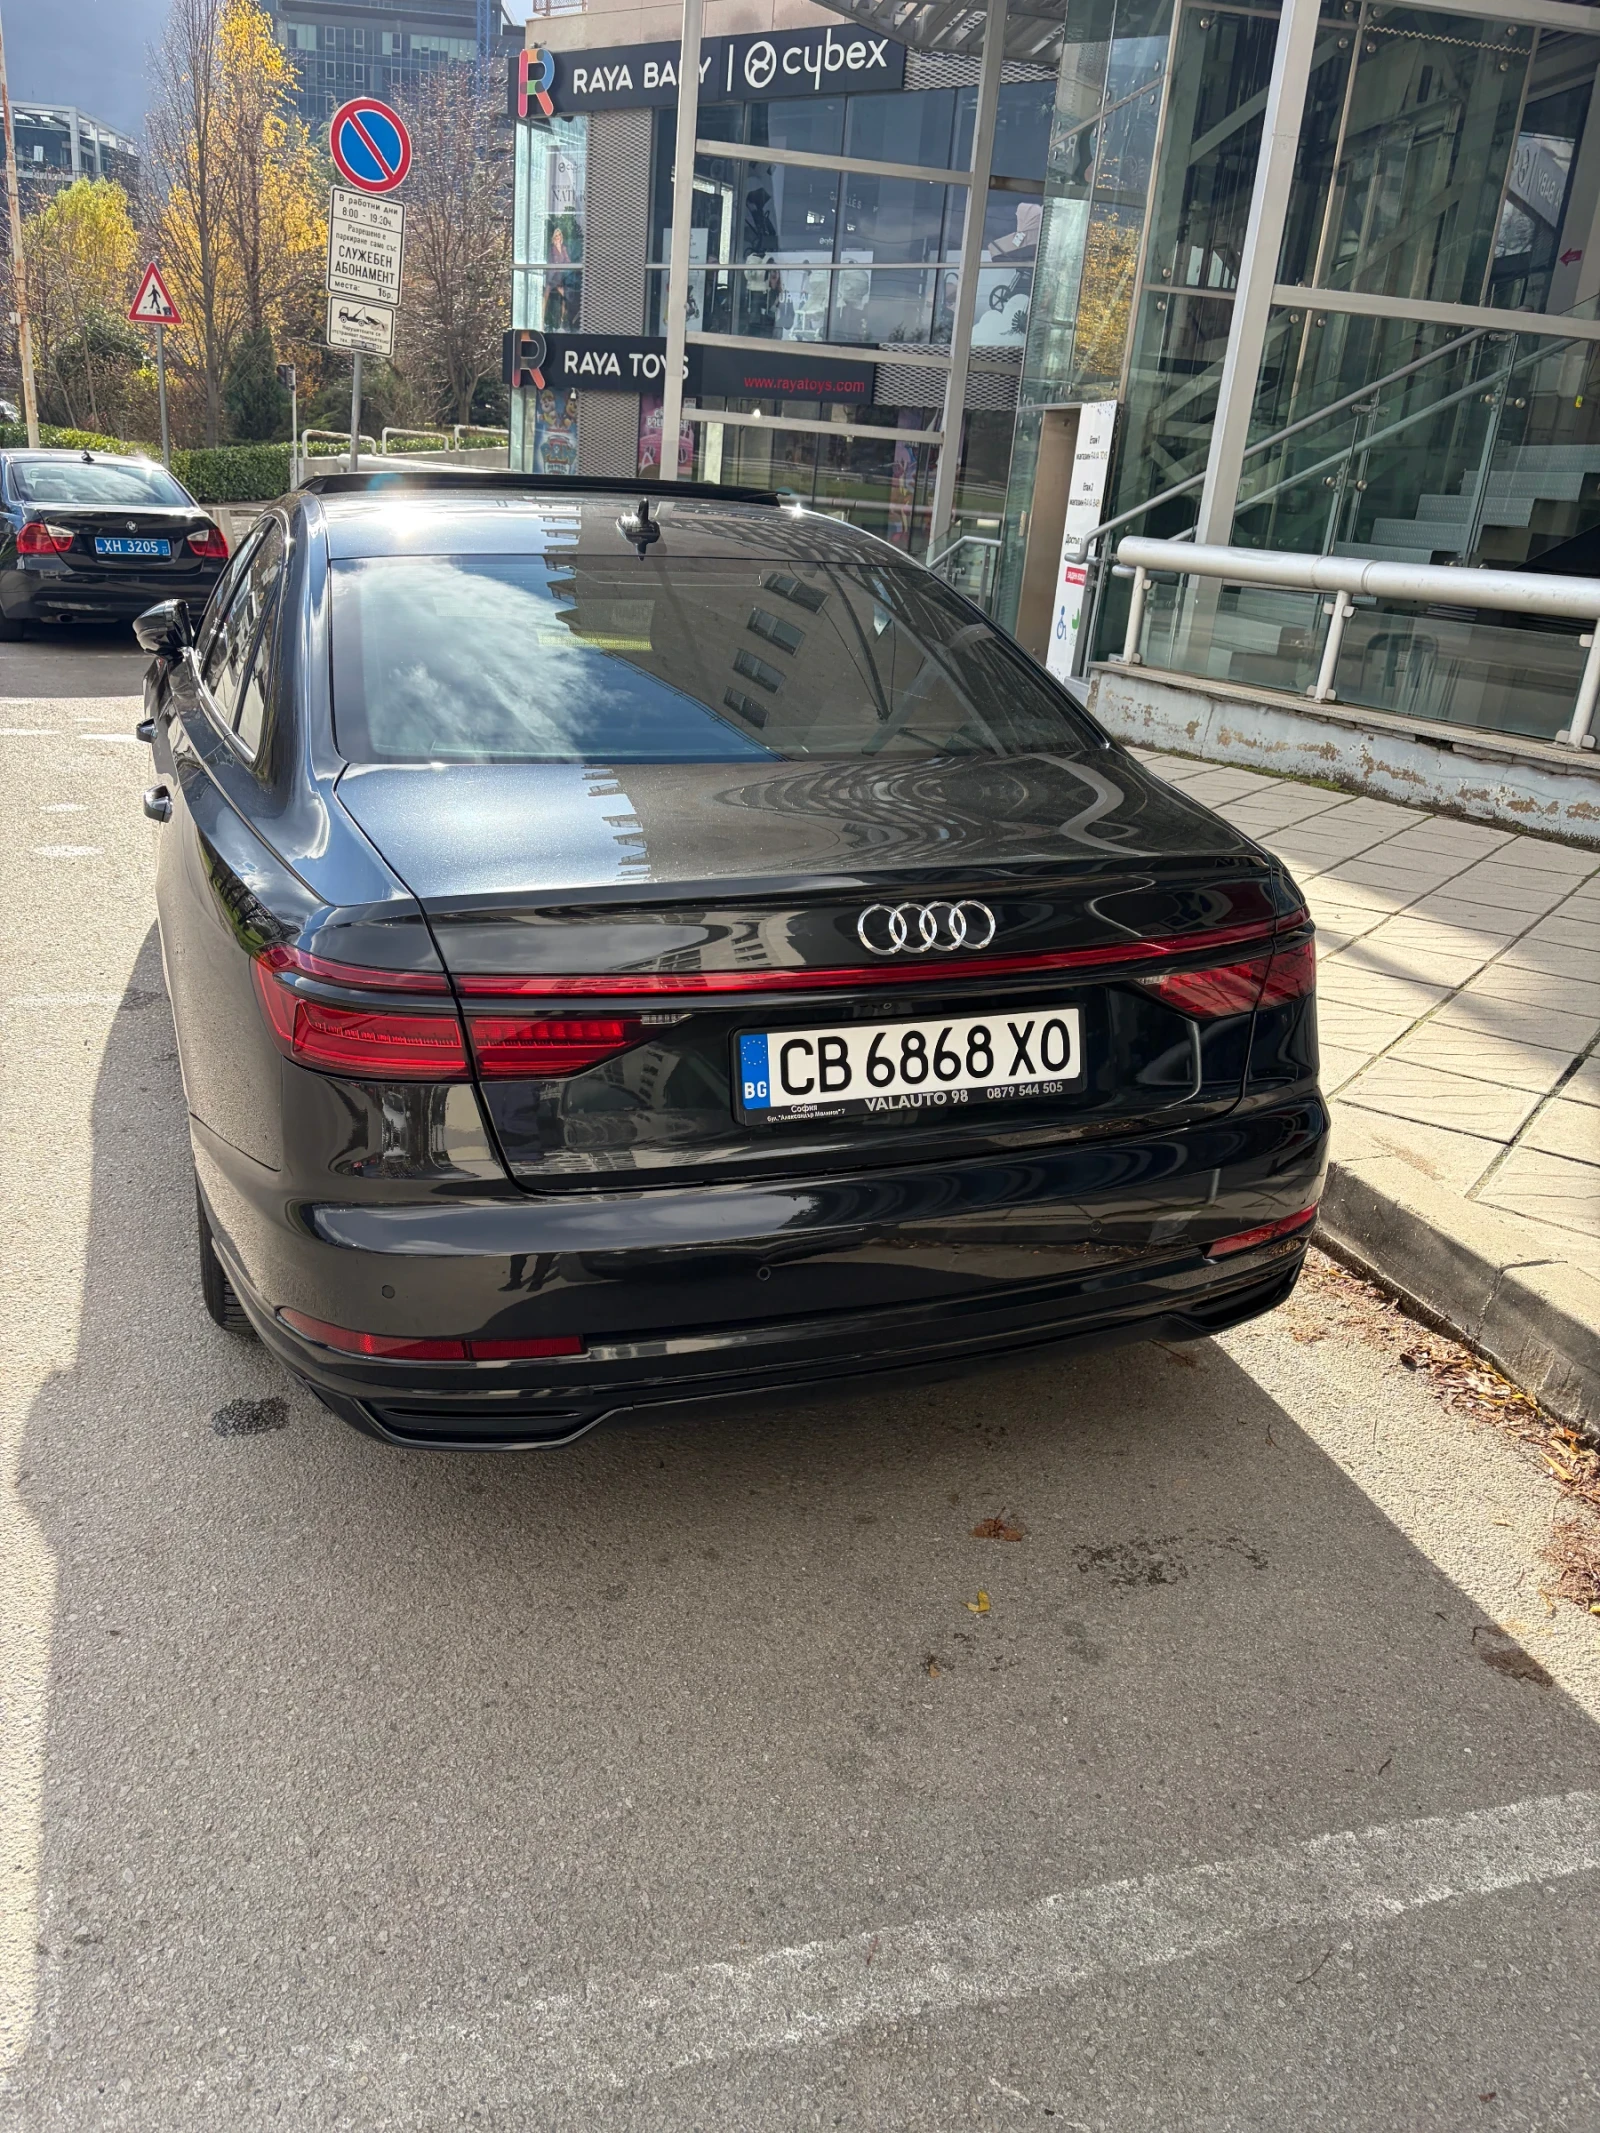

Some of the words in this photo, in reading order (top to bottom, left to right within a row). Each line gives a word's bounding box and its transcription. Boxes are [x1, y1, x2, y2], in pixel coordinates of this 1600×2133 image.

[782, 27, 889, 91] cybex
[573, 64, 634, 95] RAYA
[643, 56, 712, 89] BAY
[339, 194, 345, 202] В
[348, 197, 380, 211] работни
[383, 207, 398, 215] дни
[335, 232, 368, 246] паркиране
[370, 240, 384, 249] само
[386, 244, 398, 252] със
[347, 224, 381, 239] Разрешено
[338, 245, 393, 269] СЛУЖЕБЕН
[334, 260, 396, 285] АБОНАМЕНТ
[334, 280, 360, 291] места:
[564, 350, 622, 377] RAYA
[743, 376, 865, 395] www.rayatoys.com
[104, 539, 122, 552] XH
[127, 541, 158, 553] 3205
[780, 1035, 852, 1096] CB
[865, 1023, 995, 1088] 6868
[744, 1082, 767, 1099] BG
[864, 1092, 947, 1112] VALAUTO
[951, 1089, 969, 1104] 98
[986, 1085, 1016, 1100] 0879
[1018, 1083, 1040, 1098] 544
[1042, 1081, 1064, 1095] 505
[790, 1103, 818, 1113] София
